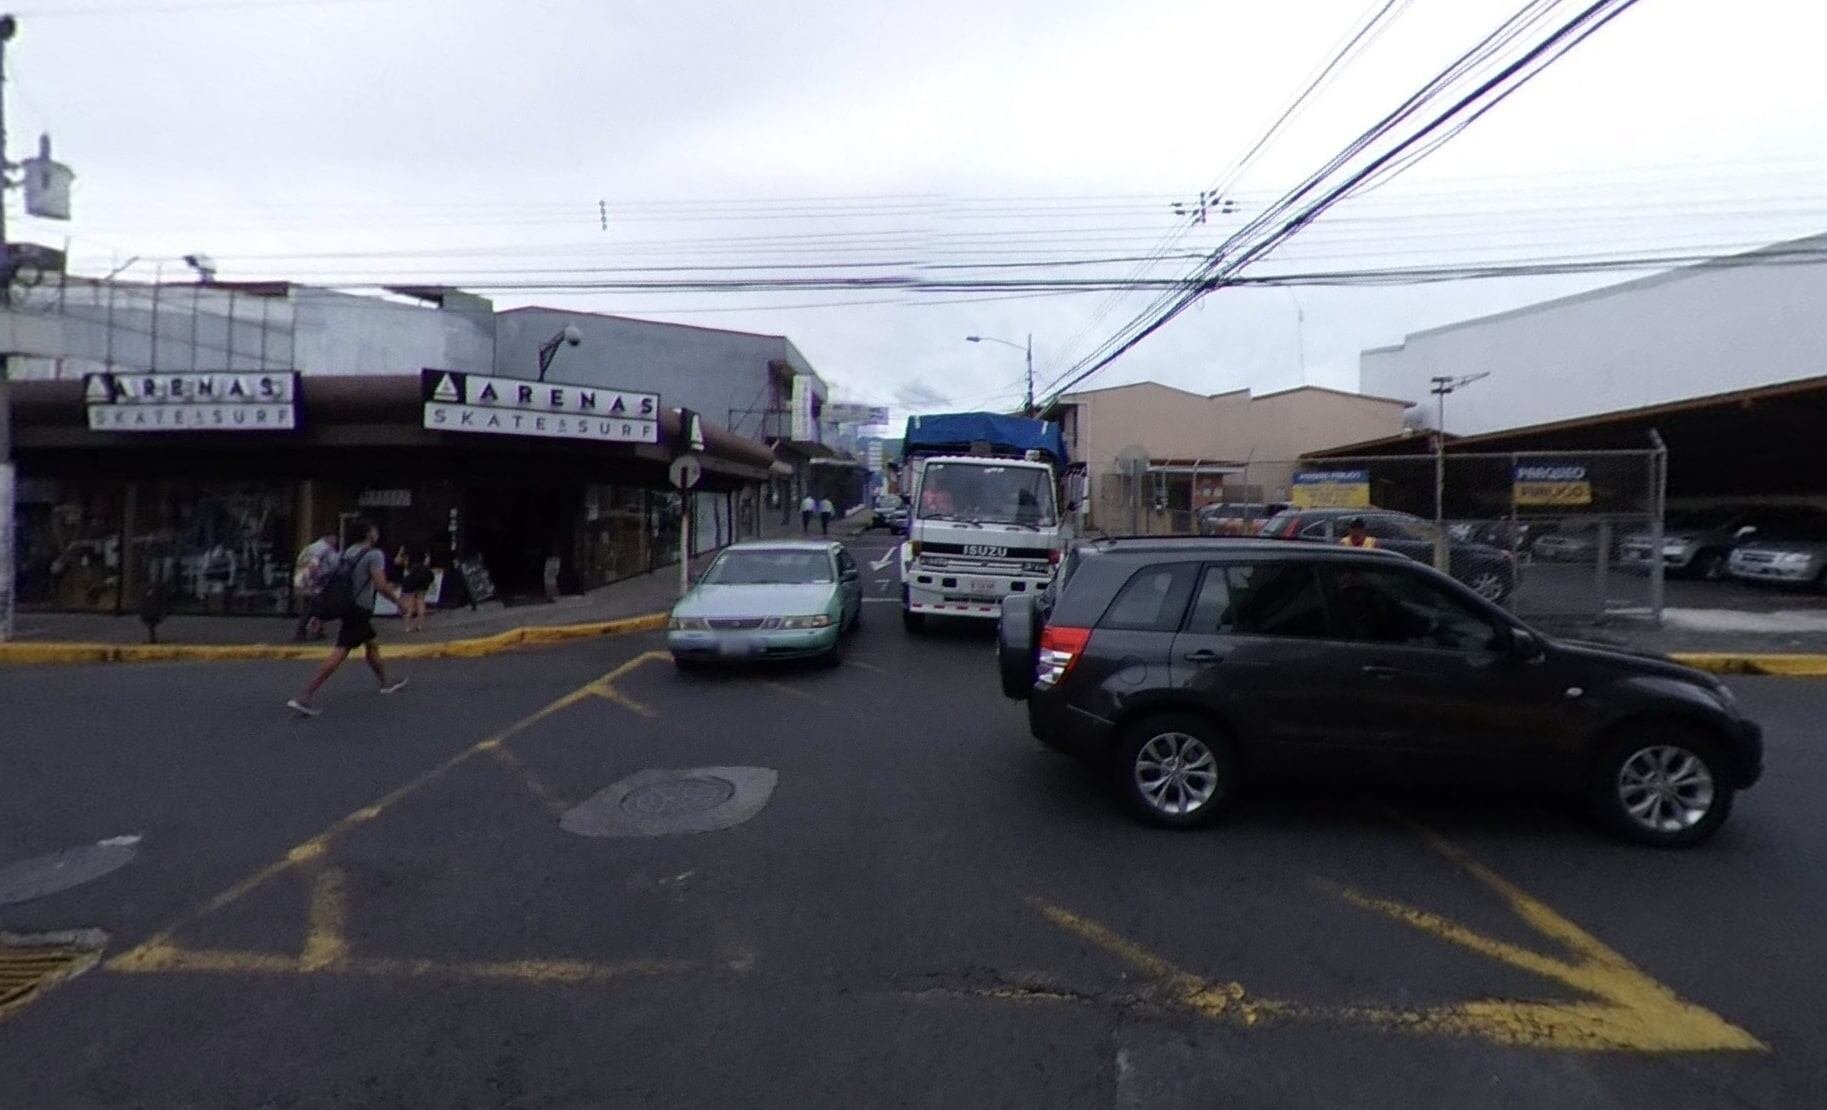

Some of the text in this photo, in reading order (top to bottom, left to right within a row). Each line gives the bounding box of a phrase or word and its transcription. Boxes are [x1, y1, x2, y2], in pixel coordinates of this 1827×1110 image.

[116, 377, 275, 397] ARENAS
[479, 382, 653, 415] ARENAS
[95, 408, 185, 425] SKATE
[212, 409, 288, 424] SURF
[433, 408, 546, 432] SKATE
[577, 419, 652, 438] SURF
[962, 544, 1008, 558] ISUZU
